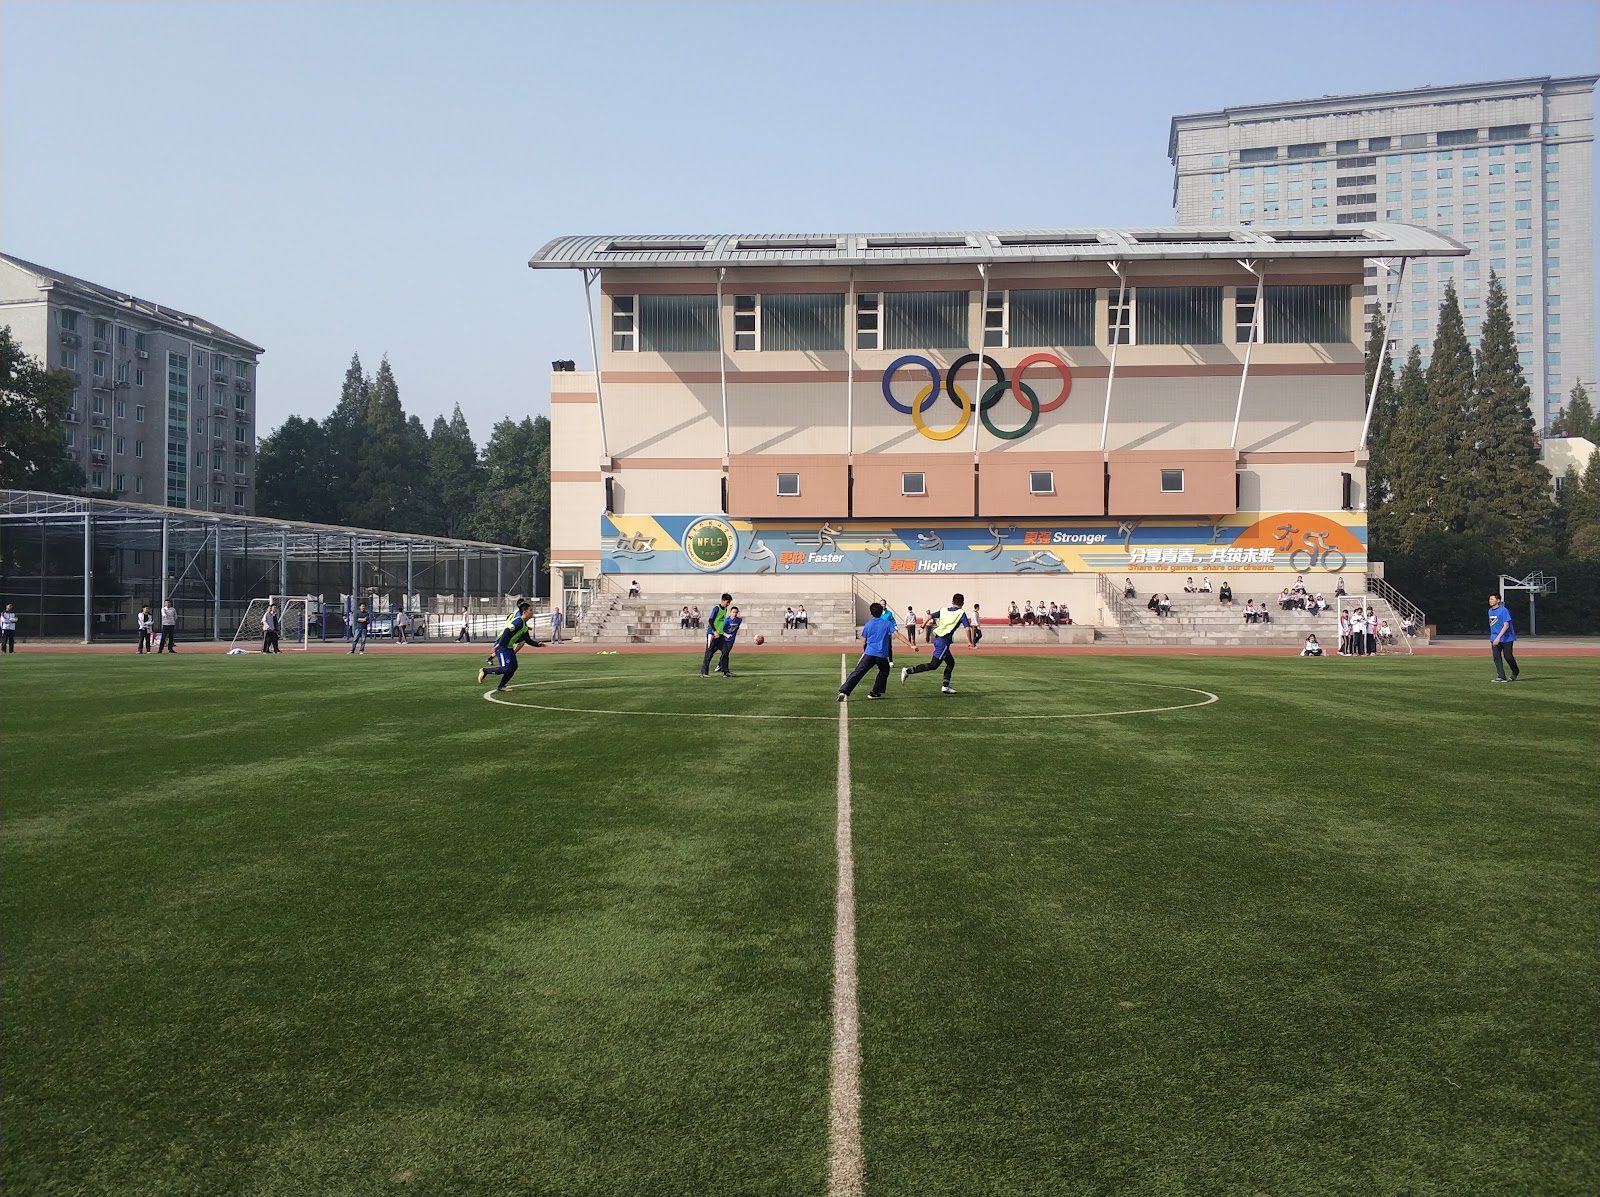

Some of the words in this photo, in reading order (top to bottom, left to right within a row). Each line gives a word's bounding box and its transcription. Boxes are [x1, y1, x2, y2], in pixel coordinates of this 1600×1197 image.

[697, 537, 723, 547] NFLS
[1053, 531, 1107, 545] Stronger
[808, 552, 845, 563] Faster
[918, 559, 958, 572] Higher
[1128, 563, 1153, 571] Share
[1171, 564, 1198, 573] games
[1202, 563, 1225, 571] share
[1243, 563, 1275, 571] dreams
